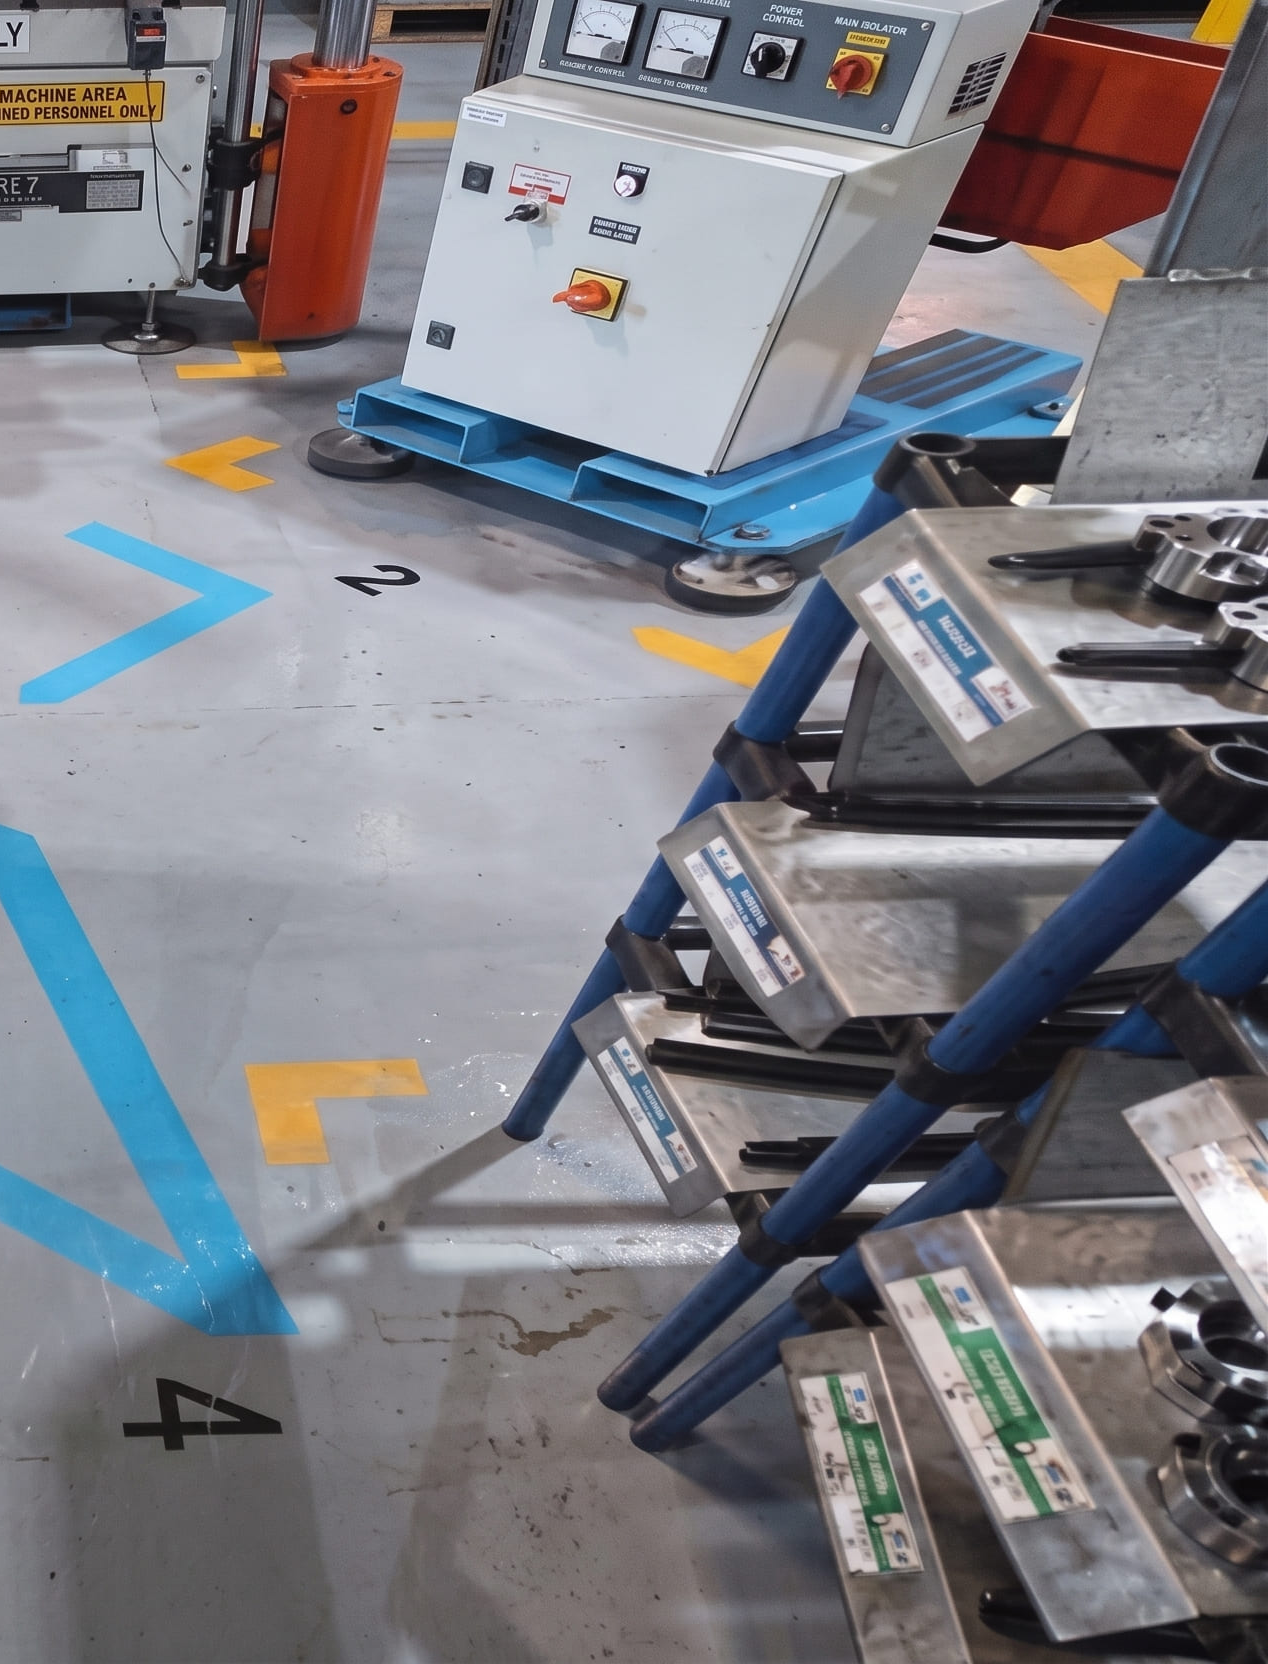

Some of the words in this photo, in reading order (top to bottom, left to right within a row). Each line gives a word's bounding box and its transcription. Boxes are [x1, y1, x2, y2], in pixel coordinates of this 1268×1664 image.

[770, 4, 804, 17] POWER
[762, 13, 805, 28] CONTROL
[834, 16, 859, 28] MAIN
[860, 20, 908, 36] ISOLATOR
[0, 88, 76, 104] MACHINE
[82, 87, 127, 102] AREA
[34, 105, 115, 120] PERSONNEL
[119, 104, 157, 118] ONLY
[334, 564, 421, 597] 2
[122, 1377, 283, 1451] 4
